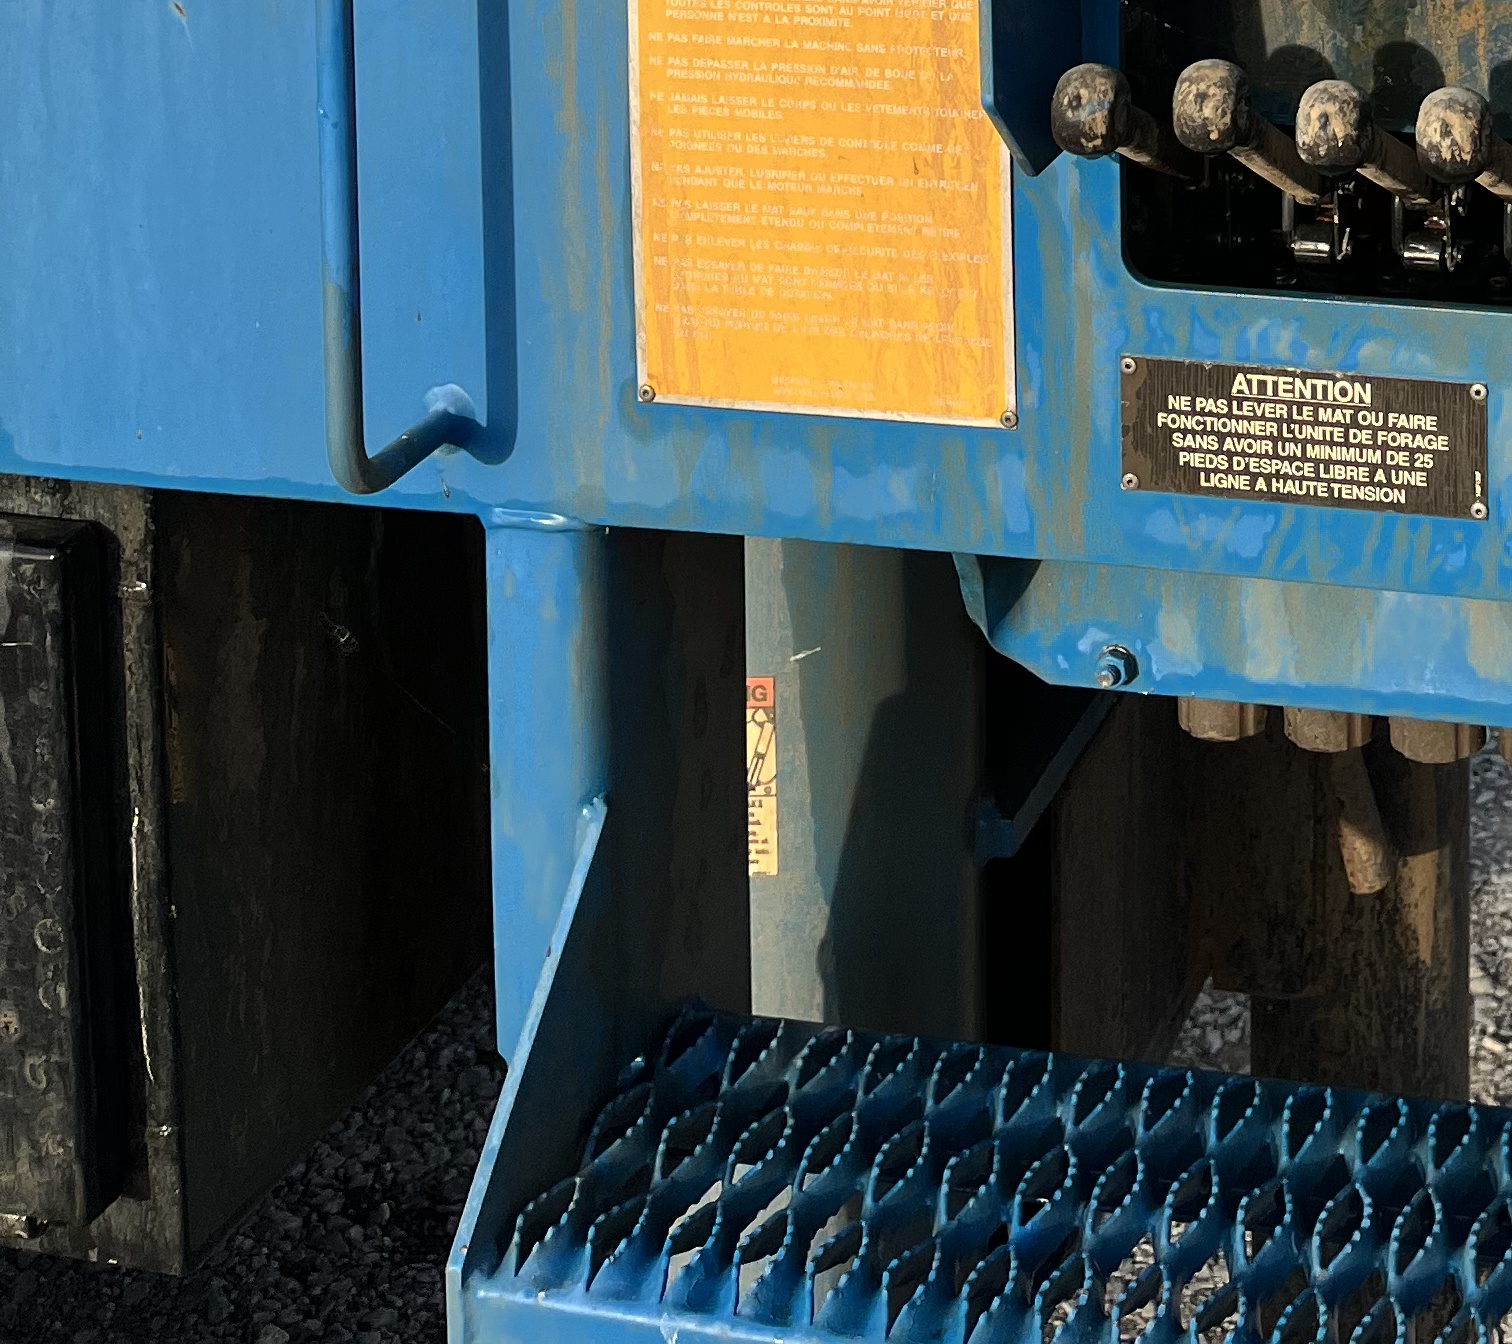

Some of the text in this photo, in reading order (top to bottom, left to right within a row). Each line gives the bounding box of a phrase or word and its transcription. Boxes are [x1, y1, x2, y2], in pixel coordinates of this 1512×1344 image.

[1231, 373, 1371, 405] ATTENTION
[1168, 396, 1437, 430] NE PAS LEVER LE MAT OU FAIRE
[1158, 414, 1449, 449] FONCTIONNER L'UNITE DE FORAGE
[1172, 432, 1434, 469] SANS AVOIR UN MINIMUM DE 25
[1179, 453, 1427, 487] PIEDS D'ESPACE LIBRE A UNE
[1200, 472, 1405, 504] LIGNE A HAUTE TENSION
